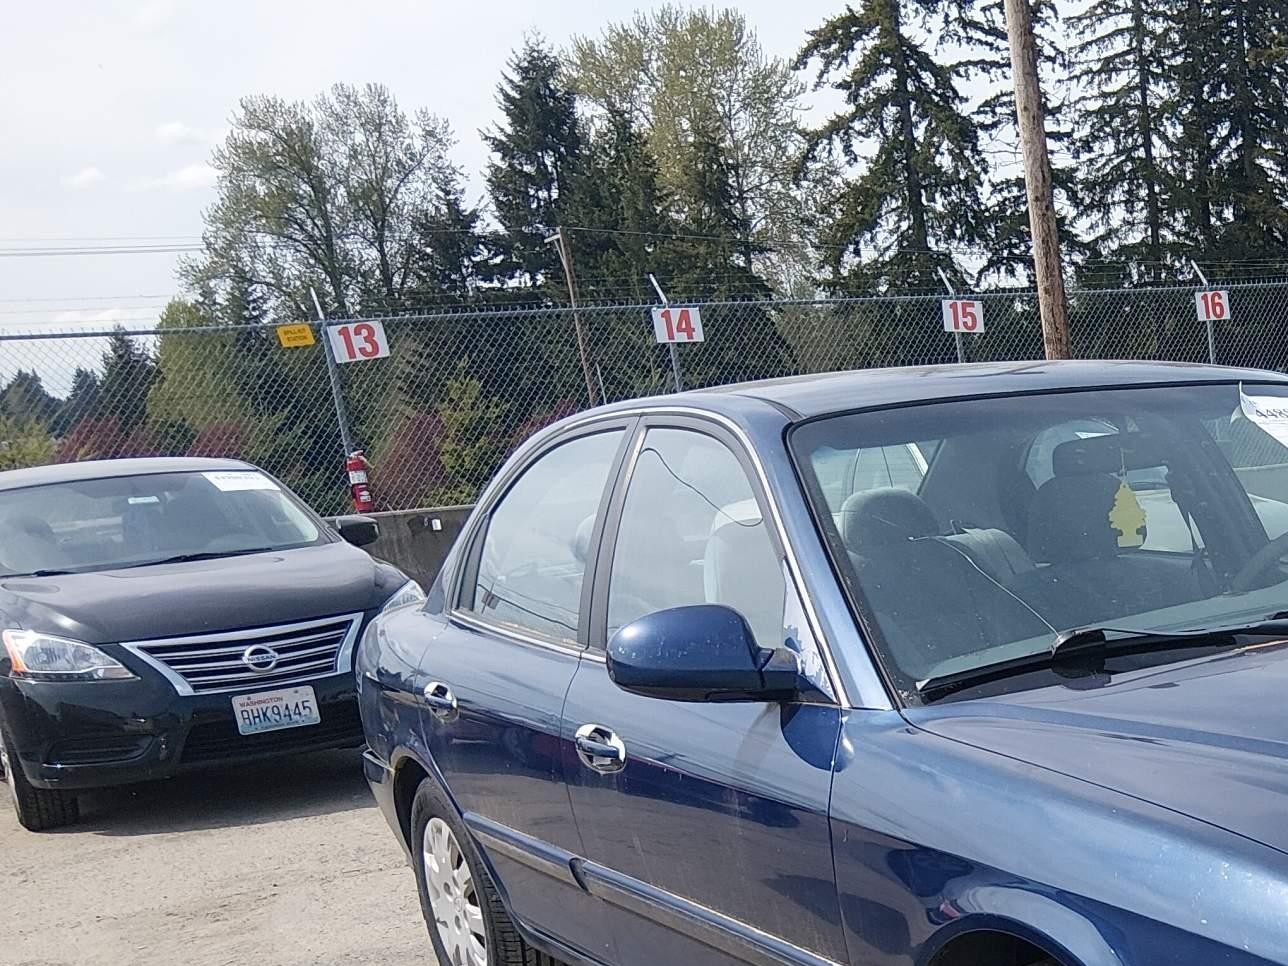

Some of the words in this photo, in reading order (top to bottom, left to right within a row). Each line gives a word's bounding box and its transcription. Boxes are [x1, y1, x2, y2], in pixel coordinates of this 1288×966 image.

[949, 301, 978, 331] 15
[1200, 291, 1225, 320] 16
[660, 309, 696, 341] 14
[337, 323, 380, 360] 13
[247, 654, 277, 663] NISSAN
[239, 697, 284, 708] WASHINGTON
